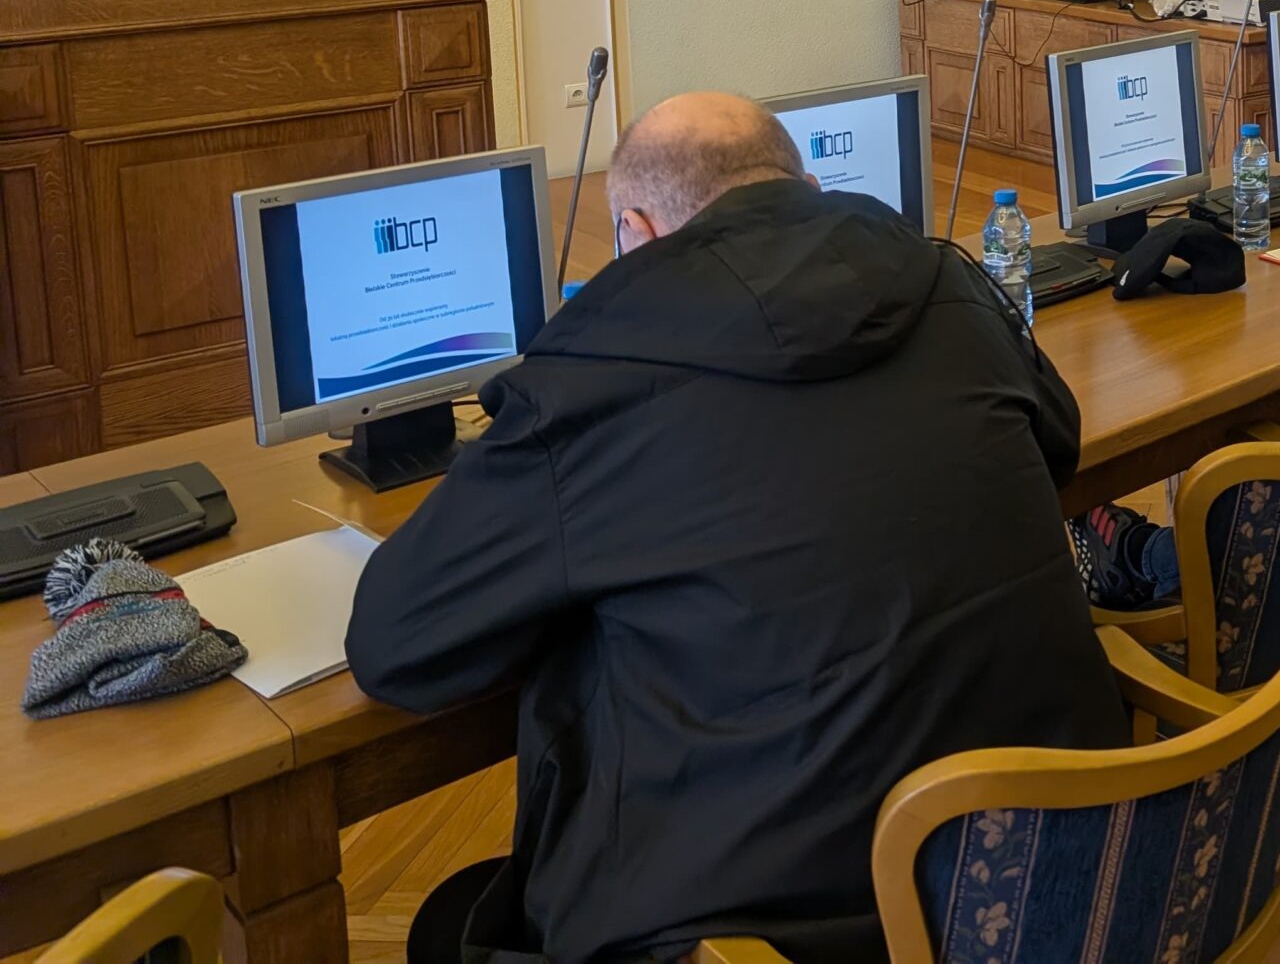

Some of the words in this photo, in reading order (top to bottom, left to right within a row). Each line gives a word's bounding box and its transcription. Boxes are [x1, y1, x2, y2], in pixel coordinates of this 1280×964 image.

[259, 196, 281, 205] NEC
[390, 267, 430, 280] Stowarzyszenie
[386, 279, 410, 290] Centrum
